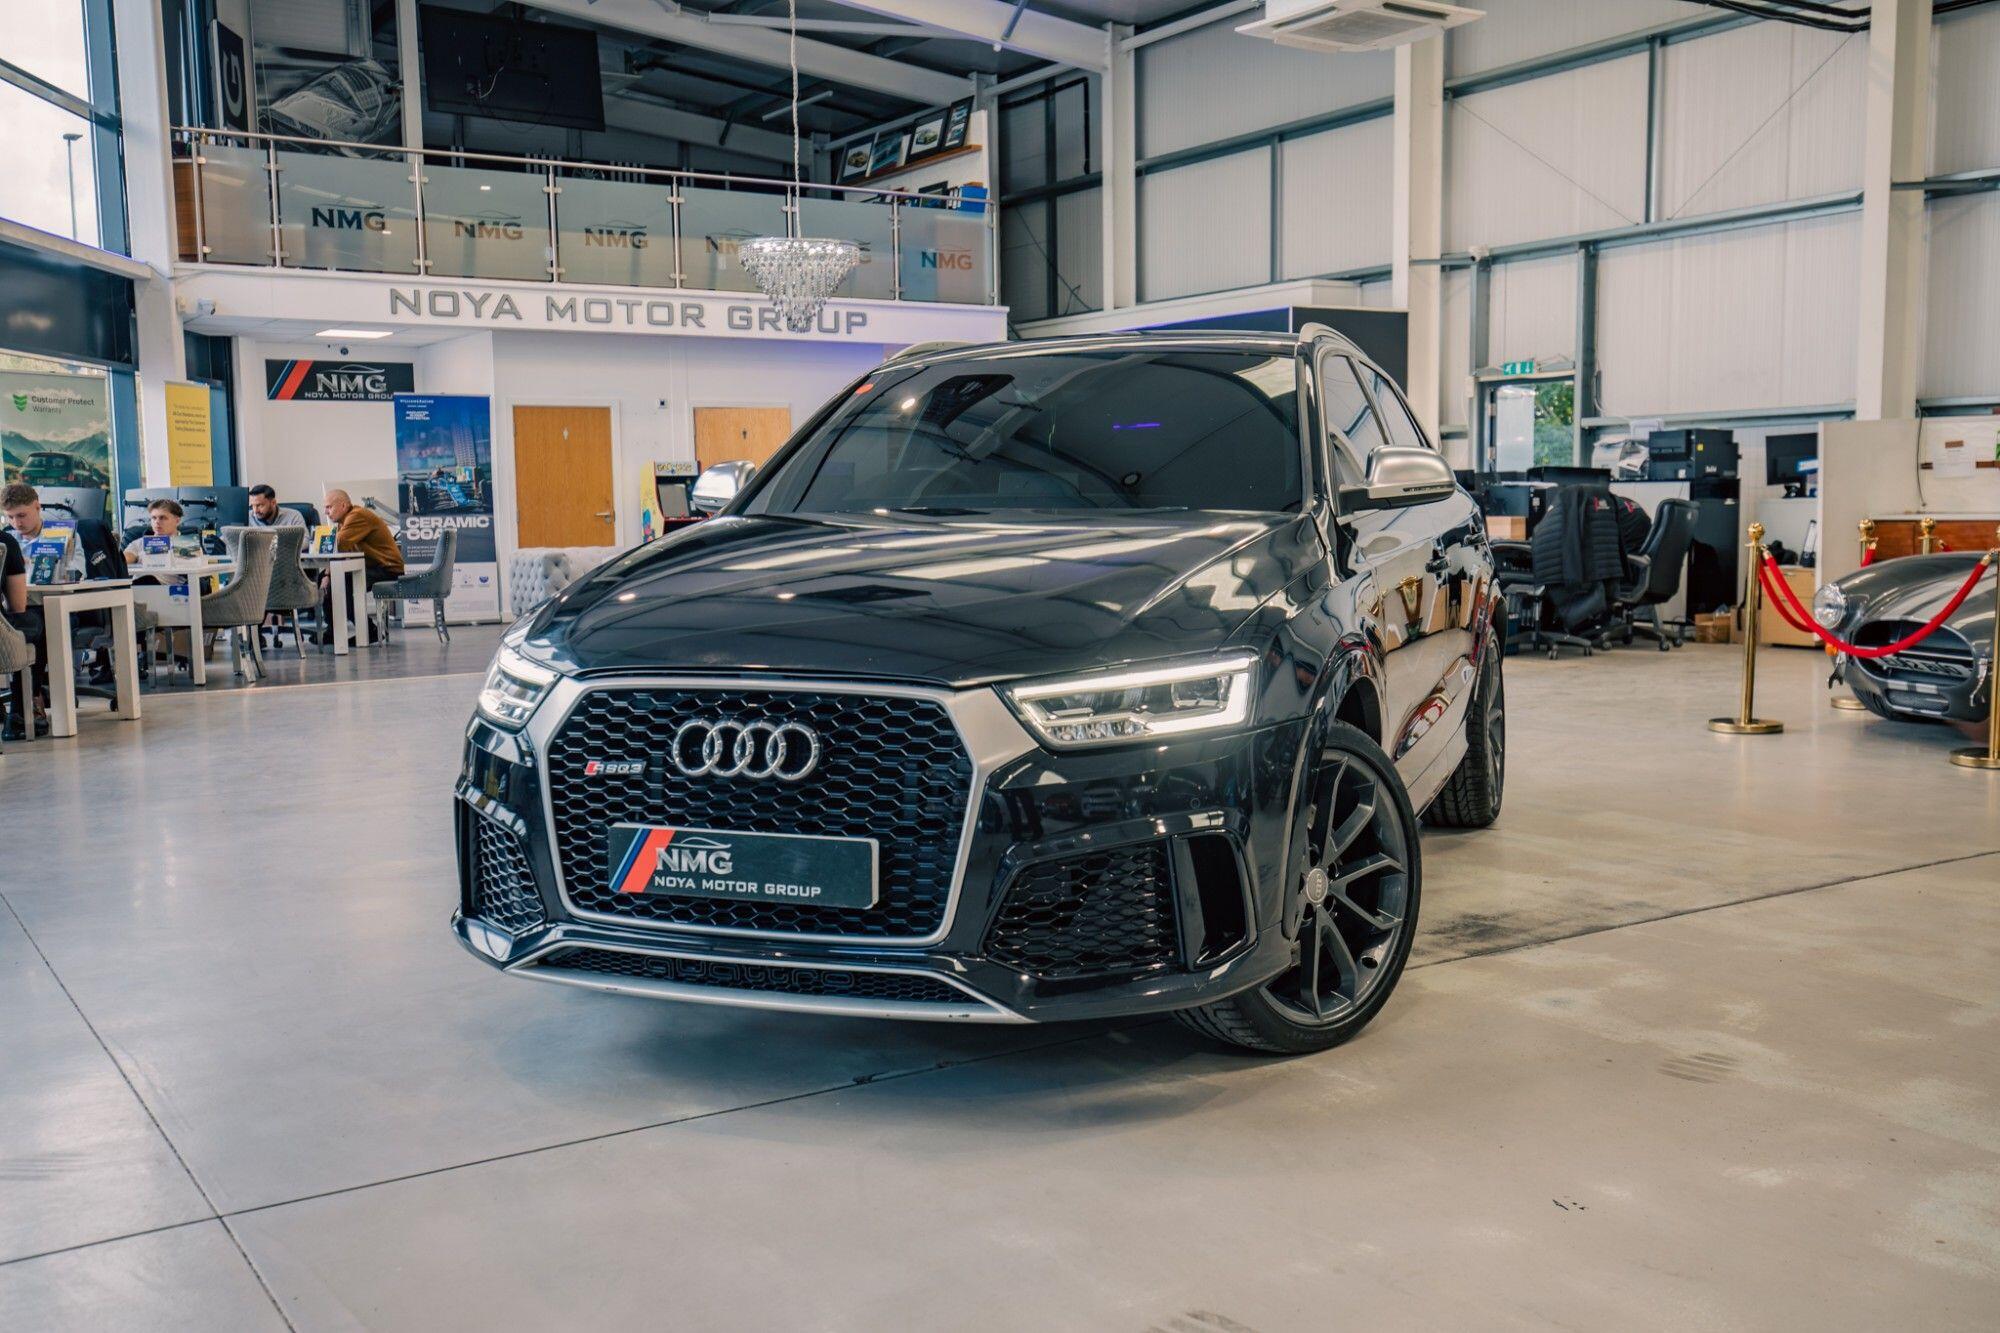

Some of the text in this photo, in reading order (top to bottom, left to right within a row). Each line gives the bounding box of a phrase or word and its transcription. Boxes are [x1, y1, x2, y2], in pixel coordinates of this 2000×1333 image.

[311, 207, 386, 231] NMG
[454, 220, 524, 240] NMG
[584, 228, 648, 249] NMG
[921, 251, 973, 270] NMG
[390, 288, 522, 320] NOYA
[546, 296, 706, 328] MOTOR
[316, 373, 387, 393] NMG
[31, 395, 95, 406] Customer Protect
[333, 392, 365, 400] MOTOR
[32, 405, 62, 414] Warranty
[405, 515, 490, 529] CERAMIC
[655, 847, 733, 875] NMG
[654, 875, 822, 898] NOYA MOTOR GROUP
